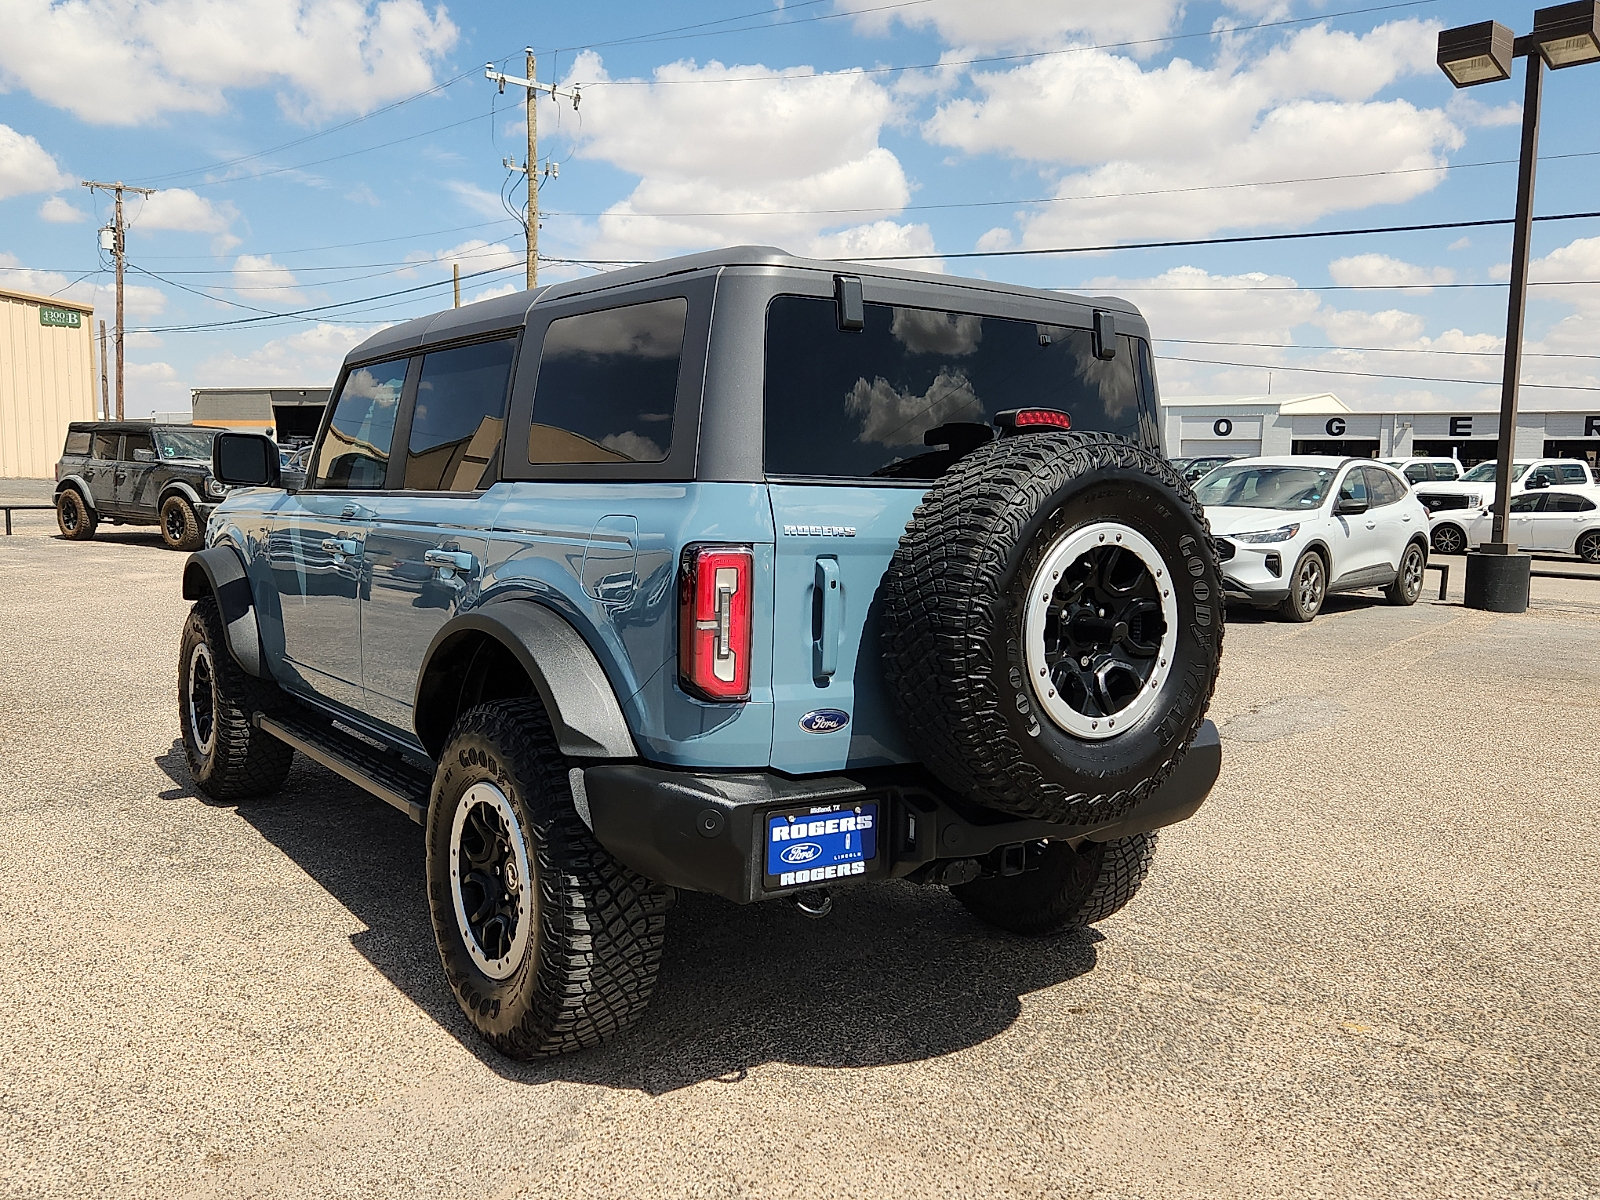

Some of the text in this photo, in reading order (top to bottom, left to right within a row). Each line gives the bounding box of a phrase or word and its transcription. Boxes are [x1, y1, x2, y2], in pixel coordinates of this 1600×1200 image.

[68, 313, 78, 323] B
[783, 524, 857, 538] ROGERS
[833, 804, 841, 812] TX
[772, 815, 873, 842] ROGERS
[788, 845, 815, 861] Ford
[833, 852, 862, 861] LINCOLN
[780, 860, 866, 886] ROGERS
